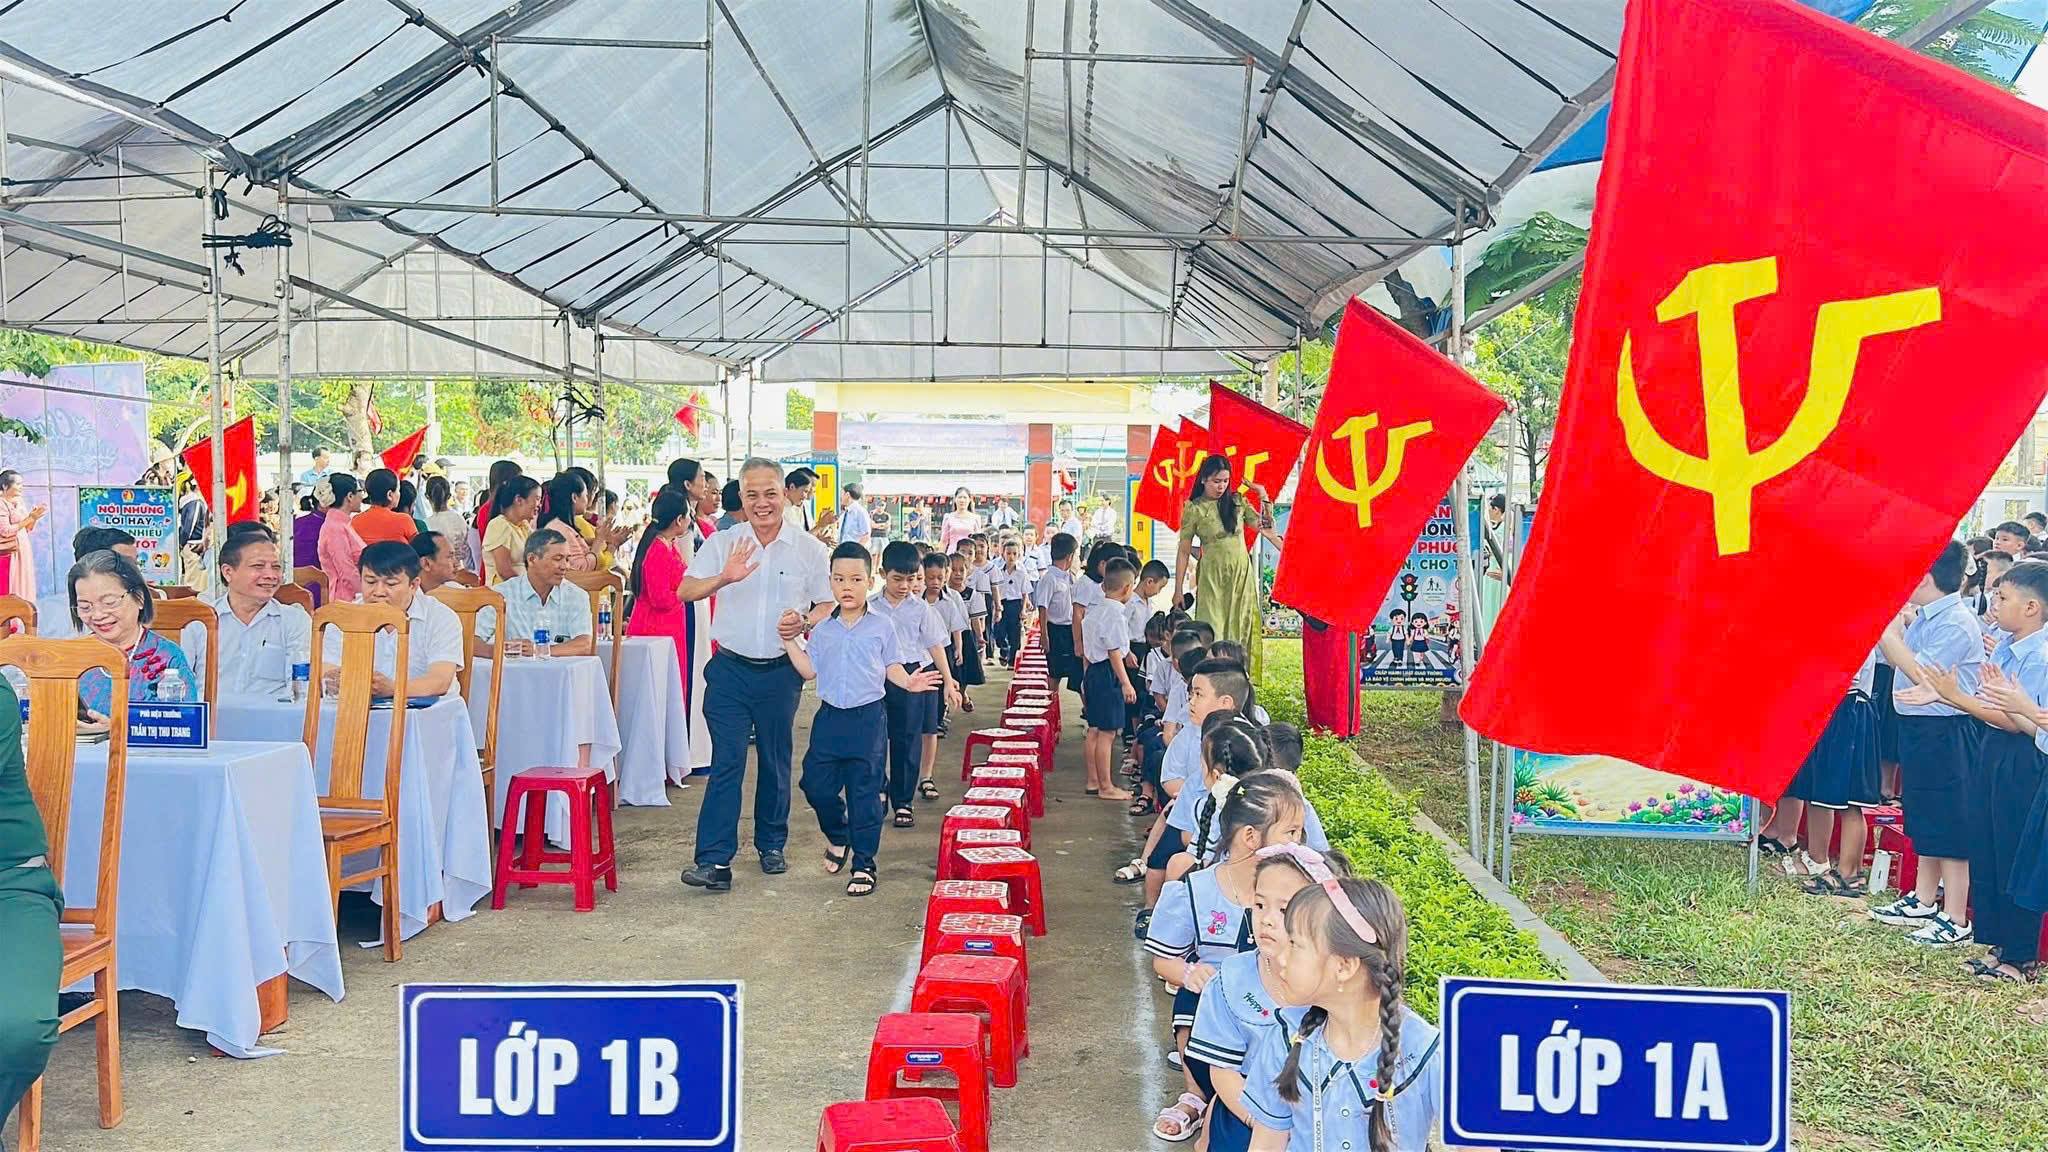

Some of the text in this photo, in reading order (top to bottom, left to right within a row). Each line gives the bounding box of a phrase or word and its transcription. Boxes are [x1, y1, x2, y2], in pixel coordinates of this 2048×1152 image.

[99, 503, 164, 514] NÓI NHỮNG
[128, 517, 155, 526] HAY,
[1420, 559, 1449, 570] CHO
[158, 727, 171, 737] THU
[171, 727, 191, 737] TRANG
[459, 1021, 681, 1116] LỚP 1B
[1500, 1020, 1729, 1121] LỚP 1A
